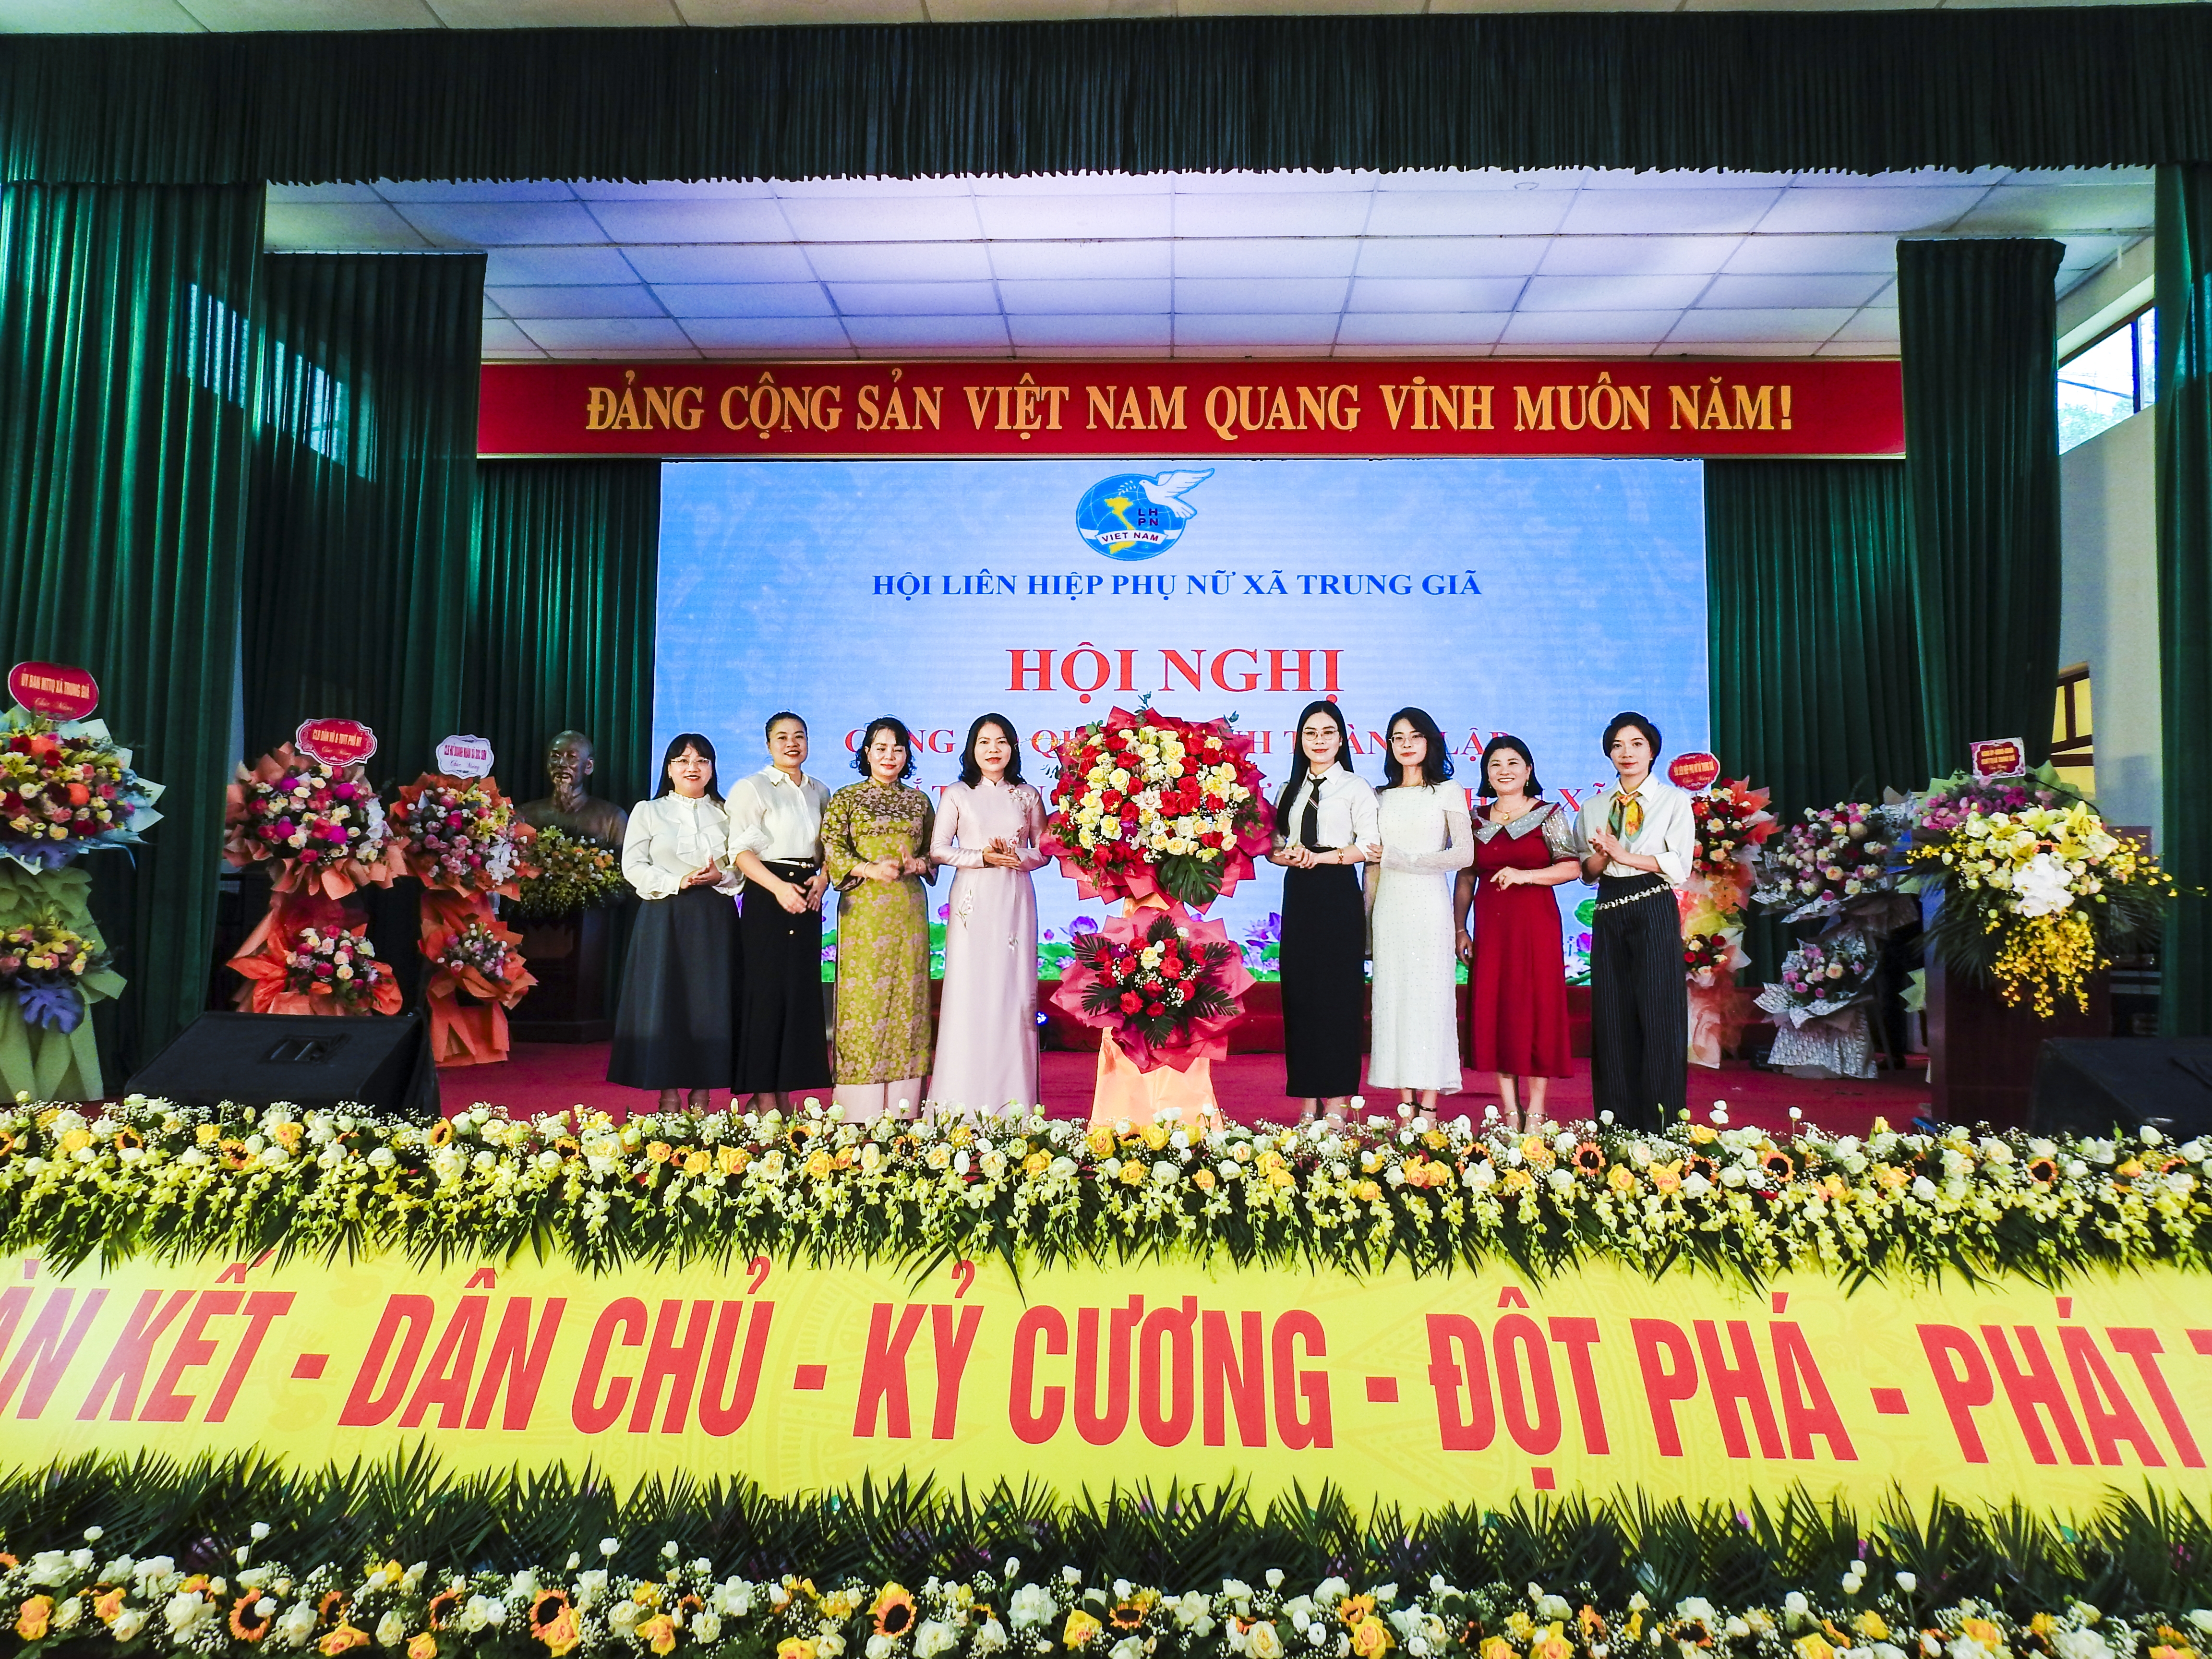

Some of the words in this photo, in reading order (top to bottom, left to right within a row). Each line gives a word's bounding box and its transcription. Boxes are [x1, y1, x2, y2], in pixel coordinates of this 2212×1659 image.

[586, 369, 704, 430] ĐẢNG
[721, 371, 842, 440] CỘNG
[856, 368, 944, 431] SẢN
[963, 373, 1070, 440] VIỆT
[1086, 386, 1188, 430] NAM
[1205, 385, 1361, 441] QUANG
[1513, 372, 1651, 431] MUÔN
[1102, 532, 1129, 542] VIET
[1133, 532, 1159, 541] NAM
[871, 571, 932, 601] HỘI
[941, 568, 1017, 595] LIÊN
[1027, 571, 1104, 601] HIỆP
[1110, 575, 1177, 601] PHỤ
[1186, 570, 1237, 595] NỮ
[1243, 570, 1288, 595] XÃ
[1297, 575, 1413, 595] TRUNG
[1421, 570, 1482, 595] GIÃ
[1005, 641, 1138, 704] HỘI
[1158, 649, 1345, 704] NGHỊ
[844, 729, 956, 753] CNG
[75, 1249, 298, 1423] KẾT
[337, 1267, 568, 1431] DÂN
[571, 1256, 776, 1437] CHỦ
[852, 1259, 985, 1440] KỶ
[1009, 1294, 1334, 1451] CƯƠNG
[1426, 1286, 1611, 1491] ĐỘT
[1629, 1291, 1859, 1461] PHÁ
[1915, 1296, 2207, 1469] PHÁT
